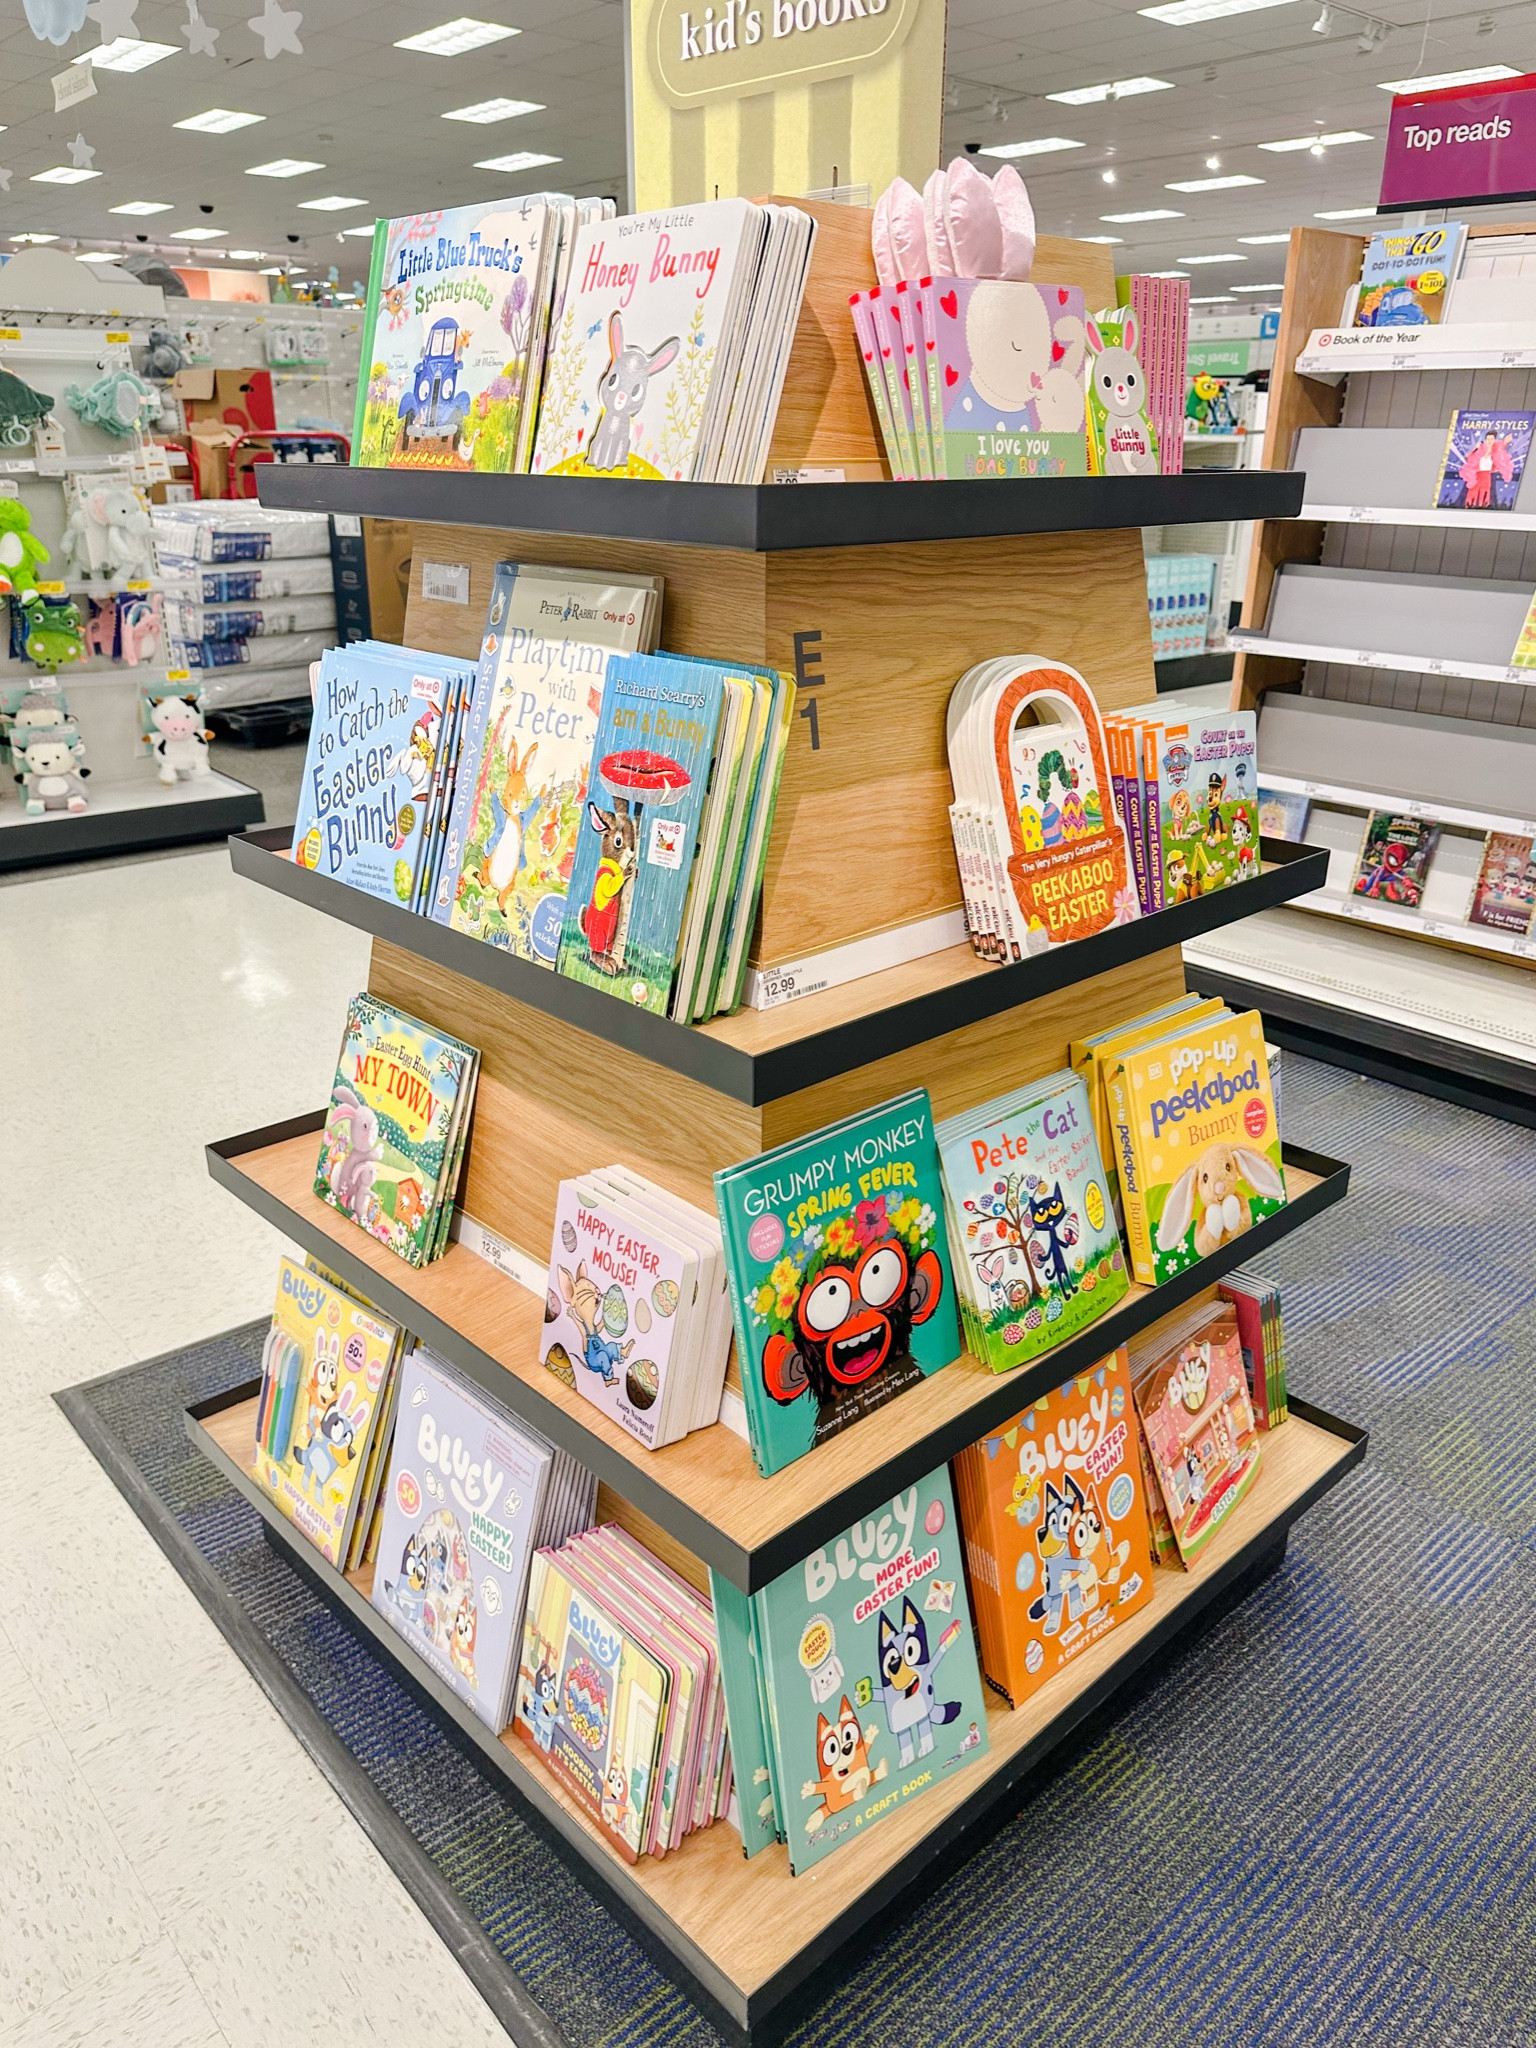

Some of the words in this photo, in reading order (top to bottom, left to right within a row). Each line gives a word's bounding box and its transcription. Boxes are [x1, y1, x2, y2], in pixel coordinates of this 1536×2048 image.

[680, 0, 761, 60] kid's
[1403, 125, 1442, 152] Top
[1446, 115, 1512, 144] reads
[618, 220, 645, 238] You're
[648, 218, 662, 234] My
[665, 214, 695, 228] Little
[1383, 236, 1415, 248] THINGS
[1411, 229, 1447, 255] GO
[397, 246, 433, 284] Little
[436, 237, 466, 271] Blue
[468, 232, 523, 273] Truck's
[580, 241, 639, 308] Honey
[649, 233, 720, 299] Bunny
[1371, 257, 1425, 271] DOT-TO-DOT
[1386, 246, 1408, 258] THAT
[415, 274, 494, 315] Springtime
[1332, 335, 1360, 345] Book
[1362, 334, 1374, 344] of
[1375, 333, 1393, 343] the
[1396, 332, 1421, 343] Year
[1115, 428, 1140, 441] Little
[1461, 420, 1494, 431] HARRY
[1494, 420, 1529, 431] STYLES
[977, 435, 986, 456] I
[991, 435, 1021, 456] love
[1110, 437, 1146, 456] Bunny
[963, 454, 1014, 478] Honey
[1019, 456, 1066, 477] Bunny
[539, 600, 562, 616] PETER
[571, 603, 599, 620] RABBIT
[603, 611, 618, 624] Only
[617, 614, 625, 622] at
[505, 627, 604, 683] Playtim
[793, 629, 825, 688] E
[327, 677, 359, 721] How
[413, 678, 425, 692] Only
[425, 681, 433, 691] at
[473, 664, 493, 734] Sticker
[549, 679, 576, 702] with
[615, 679, 658, 699] Richard
[660, 686, 706, 709] Scarry's
[318, 731, 335, 760] to
[339, 687, 385, 748] Catch
[388, 688, 409, 719] the
[515, 691, 584, 740] Peter
[613, 707, 636, 730] am
[641, 713, 650, 733] a
[654, 709, 707, 752] Bunny
[800, 697, 821, 751] 1
[1194, 743, 1228, 762] EASTER
[1229, 741, 1254, 757] PUPS!
[1200, 729, 1227, 744] COUNT
[313, 743, 393, 819] Easter
[455, 742, 478, 820] Activity
[327, 783, 397, 874] Bunny
[1149, 799, 1157, 832] COUNT
[1021, 863, 1035, 873] The
[1035, 858, 1051, 869] Very
[1051, 851, 1075, 864] Hungry
[1074, 838, 1113, 856] Caterpillar's
[1134, 839, 1144, 873] EASTER
[1152, 843, 1160, 877] EASTER
[1031, 858, 1113, 907] PEEKABOO
[1138, 876, 1147, 904] PUPS!
[1153, 880, 1161, 909] PUPS!
[544, 915, 562, 935] 50
[1048, 888, 1109, 931] EASTER
[763, 968, 780, 979] LITTLE
[765, 977, 795, 997] 12.99
[375, 1036, 398, 1057] Easter
[398, 1045, 413, 1068] Egg
[413, 1055, 431, 1080] Hunt
[1169, 1040, 1238, 1086] pop-up
[353, 1054, 384, 1087] MY
[386, 1062, 440, 1127] TOWN
[1112, 1084, 1126, 1122] pop-up
[1150, 1059, 1260, 1139] peekaboo!
[970, 1132, 1028, 1175] Pete
[1025, 1120, 1040, 1136] the
[1043, 1100, 1078, 1139] Cat
[1188, 1112, 1238, 1147] Bunny
[743, 1154, 836, 1216] GRUMPY
[844, 1114, 925, 1174] MONKEY
[1034, 1151, 1046, 1162] and
[1047, 1145, 1059, 1155] the
[1048, 1152, 1071, 1174] Easter
[1065, 1158, 1089, 1181] Bandit
[1117, 1124, 1139, 1194] peekaboo!
[787, 1182, 852, 1238] SPRING
[858, 1161, 918, 1198] FEVER
[577, 1208, 615, 1246] HAPPY
[616, 1234, 660, 1279] EASTER,
[753, 1223, 778, 1238] INCLUDES
[761, 1234, 772, 1243] FUN
[1129, 1201, 1145, 1251] Bunny
[482, 1240, 501, 1259] 12.99
[756, 1238, 780, 1253] STICKERS
[592, 1246, 637, 1291] MOUSE!
[281, 1268, 327, 1319] BLUEY
[348, 1343, 363, 1358] 50+
[1036, 1335, 1046, 1344] by
[1048, 1319, 1073, 1338] Kimberly
[1168, 1339, 1211, 1405] BLUEY
[816, 1415, 842, 1436] Suzanne
[842, 1406, 859, 1420] Lang
[891, 1378, 904, 1389] Max
[904, 1368, 920, 1381] Lang
[1019, 1388, 1109, 1482] BLUEY
[1085, 1424, 1126, 1471] EASTER
[417, 1413, 504, 1515] BLUEY
[1095, 1446, 1123, 1482] FUN!
[284, 1480, 305, 1508] HAPPY
[306, 1504, 334, 1539] EASTER,
[401, 1483, 415, 1508] 50
[1212, 1485, 1237, 1523] EASTER
[295, 1506, 319, 1538] BLUEY!
[472, 1511, 511, 1547] HAPPY
[470, 1529, 511, 1569] EASTER!
[805, 1487, 917, 1603] BLUEY
[856, 1577, 904, 1620] EASTER
[907, 1551, 938, 1583] FUN!
[876, 1550, 913, 1587] MORE
[569, 1600, 621, 1668] BLUEY
[804, 1630, 826, 1653] EASTER
[806, 1637, 827, 1660] POUCH
[1058, 1654, 1064, 1665] A
[1065, 1633, 1090, 1659] CRAFT
[1092, 1615, 1115, 1638] BOOK
[408, 1632, 430, 1657] PUFFY
[429, 1653, 457, 1688] STICKER
[554, 1743, 569, 1767] IT'S
[569, 1763, 600, 1803] EASTER!
[562, 1740, 595, 1784] HOORAY,
[855, 1815, 862, 1827] A
[865, 1790, 899, 1819] CRAFT
[902, 1770, 932, 1796] BOOK
